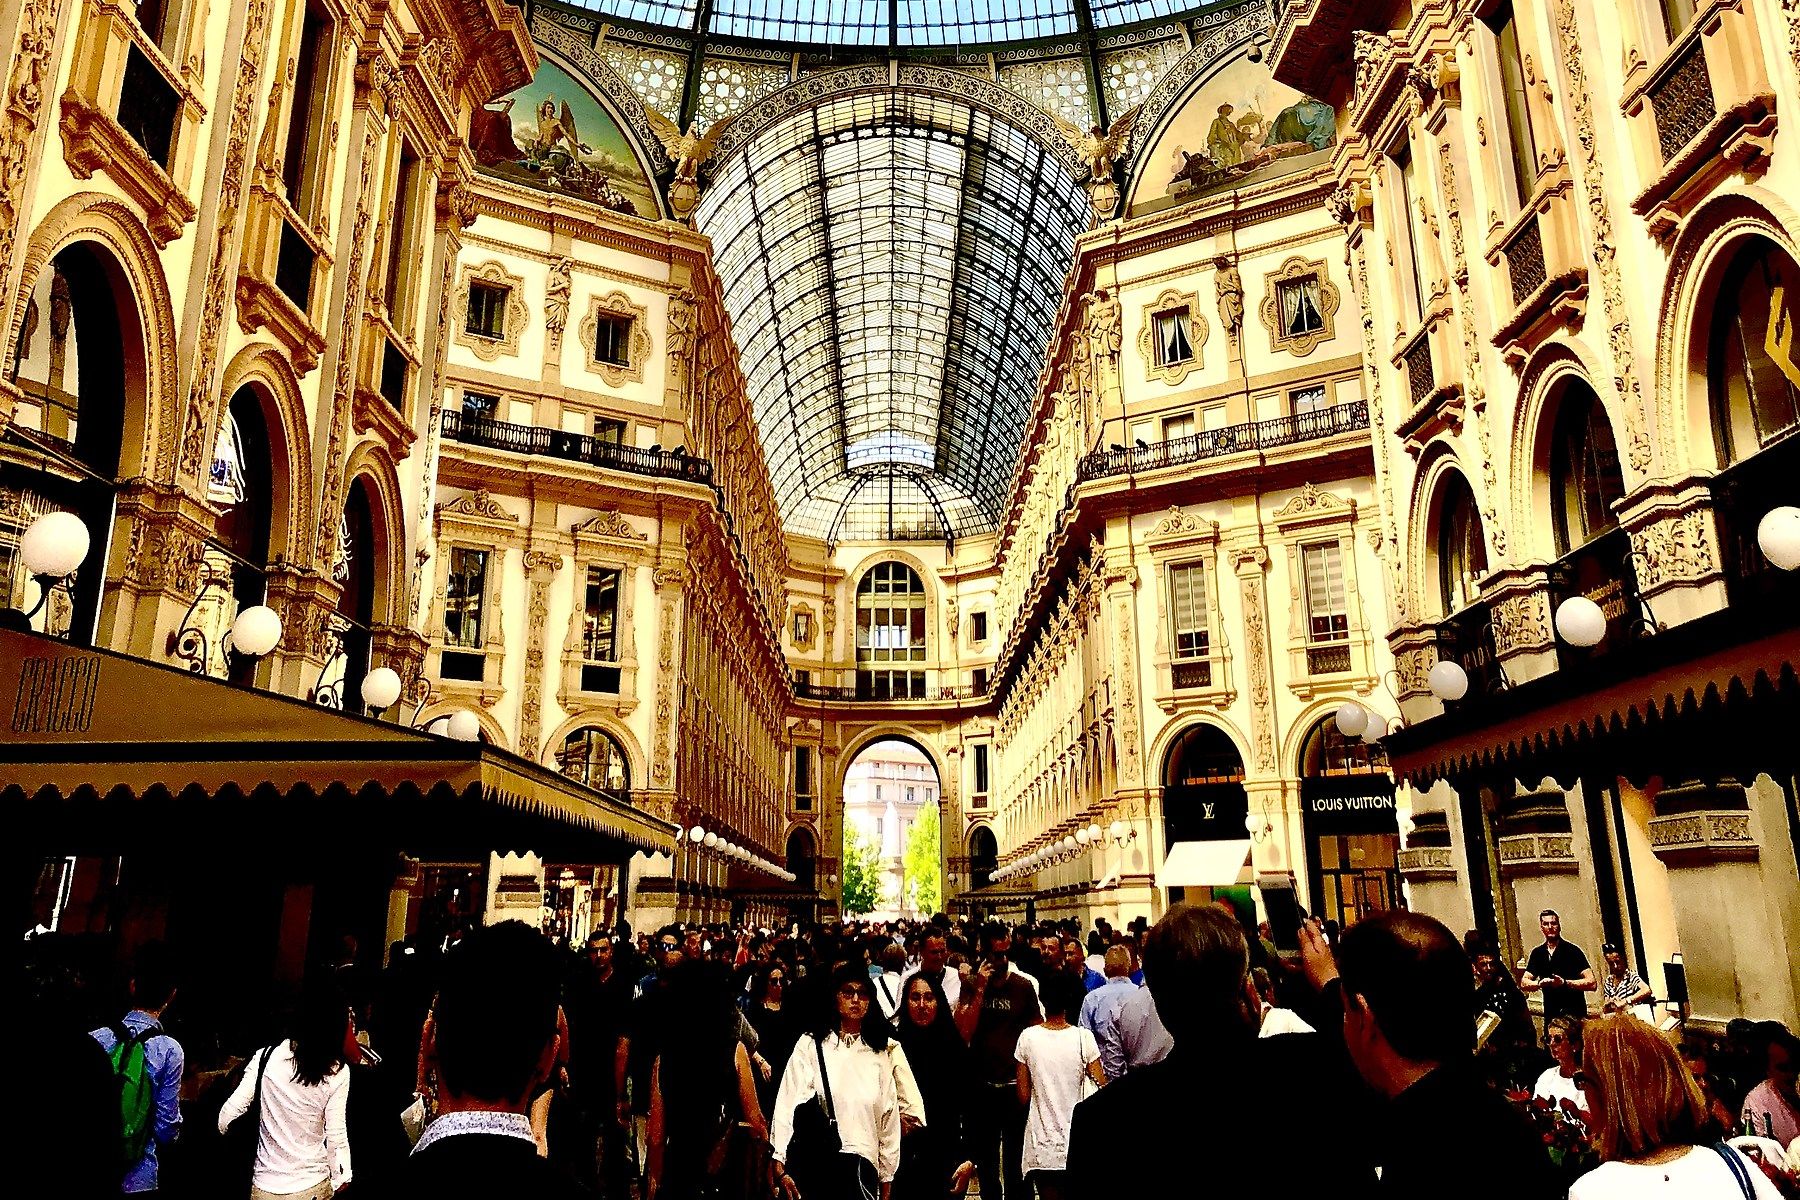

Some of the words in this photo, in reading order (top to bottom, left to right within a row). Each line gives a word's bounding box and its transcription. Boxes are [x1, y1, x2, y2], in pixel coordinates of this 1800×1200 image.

[12, 656, 101, 732] CRACCO
[1312, 798, 1343, 812] LOUIS
[1344, 795, 1393, 810] VUITTON
